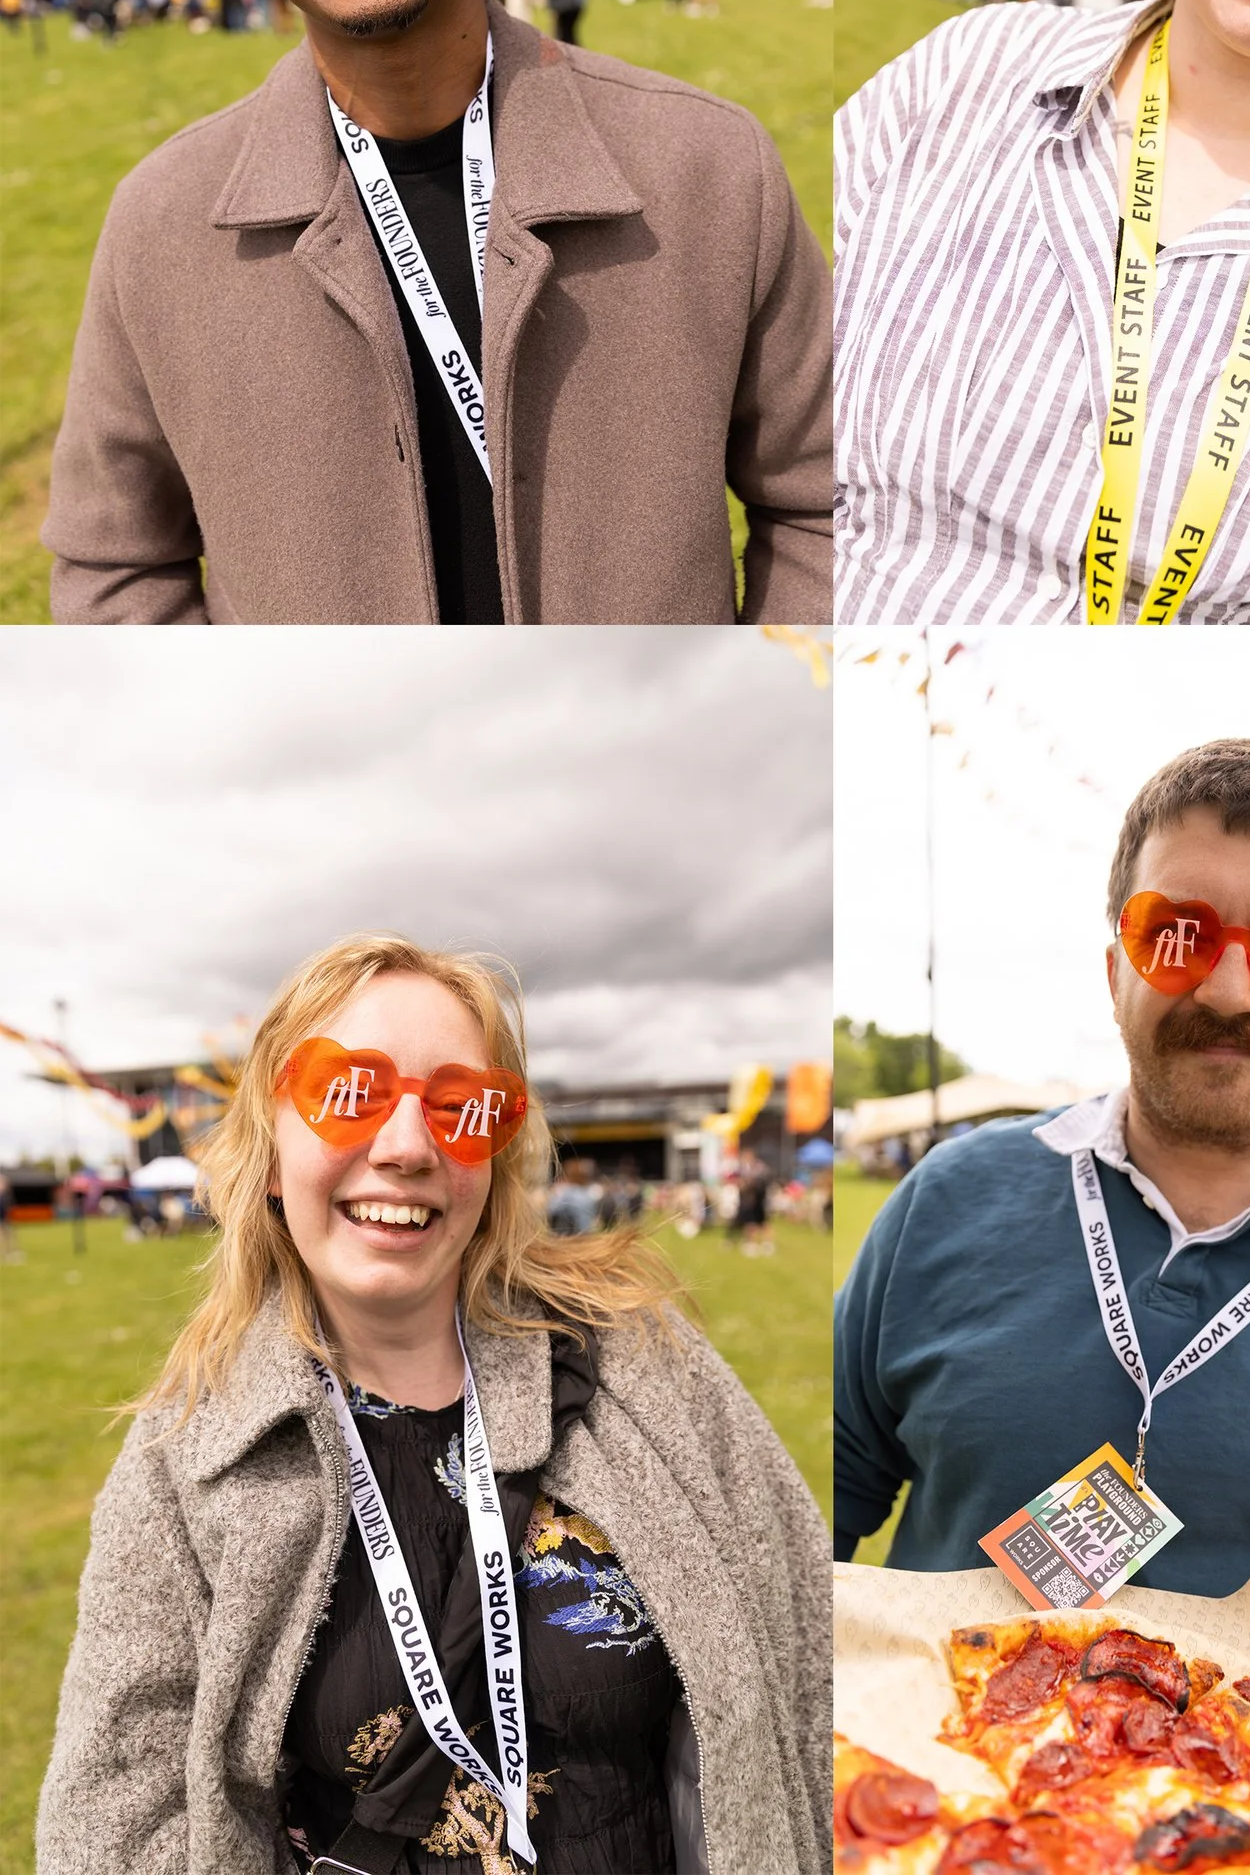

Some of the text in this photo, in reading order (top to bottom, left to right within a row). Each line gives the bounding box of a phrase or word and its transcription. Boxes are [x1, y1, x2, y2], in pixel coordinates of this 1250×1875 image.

[466, 155, 484, 176] for
[470, 179, 485, 199] the
[1132, 93, 1161, 223] EVENT STAFF
[366, 178, 447, 319] for the FOUNDERS
[1108, 257, 1148, 446] EVENT STAFF
[1093, 506, 1122, 615] STAFF
[1089, 1222, 1143, 1381] SQUARE WORKS
[1163, 1322, 1231, 1384] WORKS
[465, 1379, 500, 1516] for the FOUNDERS
[350, 1458, 395, 1561] FOUNDERS
[1073, 1493, 1127, 1546] PLAY
[1092, 1472, 1142, 1526] PLAYGROUND
[1100, 1469, 1148, 1519] the FOUNDERS
[1009, 1549, 1025, 1566] WORKS
[1016, 1542, 1034, 1560] ARE
[1031, 1555, 1062, 1582] SPONSOR
[388, 1587, 503, 1797] SQUARE WORKS
[484, 1550, 525, 1788] SQUARE WORKS
